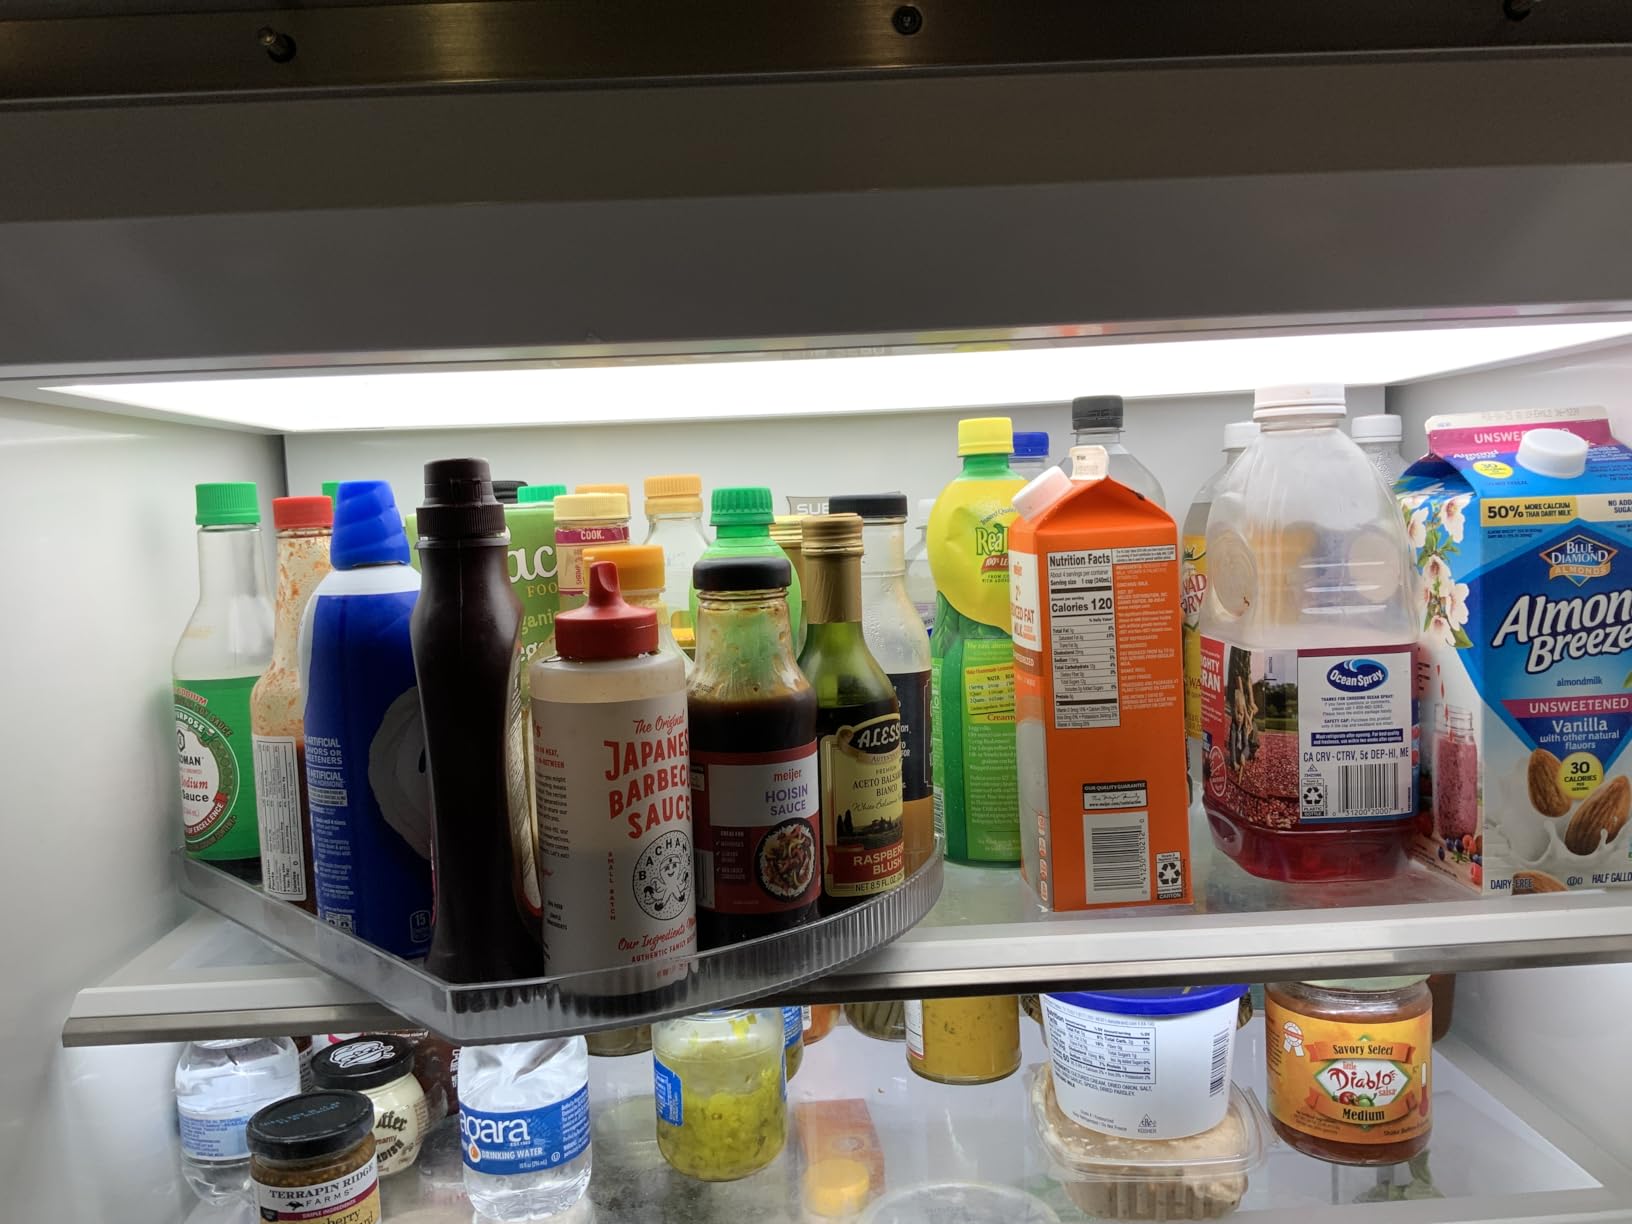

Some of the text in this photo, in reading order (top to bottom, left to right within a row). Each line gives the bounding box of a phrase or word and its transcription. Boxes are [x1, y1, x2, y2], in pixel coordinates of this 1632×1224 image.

[1487, 504, 1524, 520] 50%
[1524, 501, 1571, 511] MORE CALCIUM
[1525, 510, 1541, 518] THAN
[1566, 541, 1594, 554] BLUE
[1049, 554, 1086, 568] Nutrition
[1087, 552, 1111, 566] Facts
[1551, 550, 1609, 565] DIAMOND
[1554, 565, 1607, 576] ALMONDS
[1051, 597, 1113, 613] Calories 120
[1493, 588, 1632, 648] Almon
[1527, 622, 1632, 672] Breeze
[1329, 669, 1384, 688] Ocean Spray
[1556, 676, 1604, 687] almondmilk
[1529, 697, 1629, 714] UNSWEETENED
[632, 707, 686, 736] The Original
[1551, 717, 1609, 733] Vanilla
[1538, 730, 1620, 744] with other natural
[1564, 740, 1597, 751] flavors
[329, 749, 343, 758] OR
[1303, 751, 1314, 763] CA
[1315, 750, 1331, 763] CRV
[1361, 749, 1370, 761] 5¢
[1399, 747, 1409, 758] ME
[773, 768, 803, 782] meijer
[1569, 761, 1591, 775] 30
[852, 775, 881, 791] ACETO
[1563, 775, 1598, 783] CALORIES
[609, 764, 691, 819] BARBEC
[765, 783, 808, 803] HOISIN
[875, 784, 899, 798] BIANCO
[1097, 784, 1118, 792] QUALITY
[1118, 782, 1146, 791] GUARANTEE
[769, 799, 807, 816] SAUCE
[1345, 808, 1369, 818] 31200
[193, 801, 226, 834] EXCELLENCE
[628, 795, 691, 839] SAUCE
[872, 855, 902, 875] BLUSH
[1591, 873, 1610, 884] HALF
[855, 881, 869, 892] NET
[870, 880, 881, 891] 8.5
[617, 924, 686, 953] Our Ingredients
[631, 949, 668, 963] AUTHENTIC
[1332, 1043, 1394, 1056] Savory Select
[1099, 1085, 1115, 1095] DRIED
[1106, 1082, 1122, 1090] DRIED
[1377, 1089, 1397, 1098] salsa
[1341, 1107, 1385, 1122] Medium
[480, 1147, 544, 1161] DRINKING WATER
[269, 1161, 374, 1201] TERRAPIN RIDGE
[304, 1187, 349, 1208] FARMS
